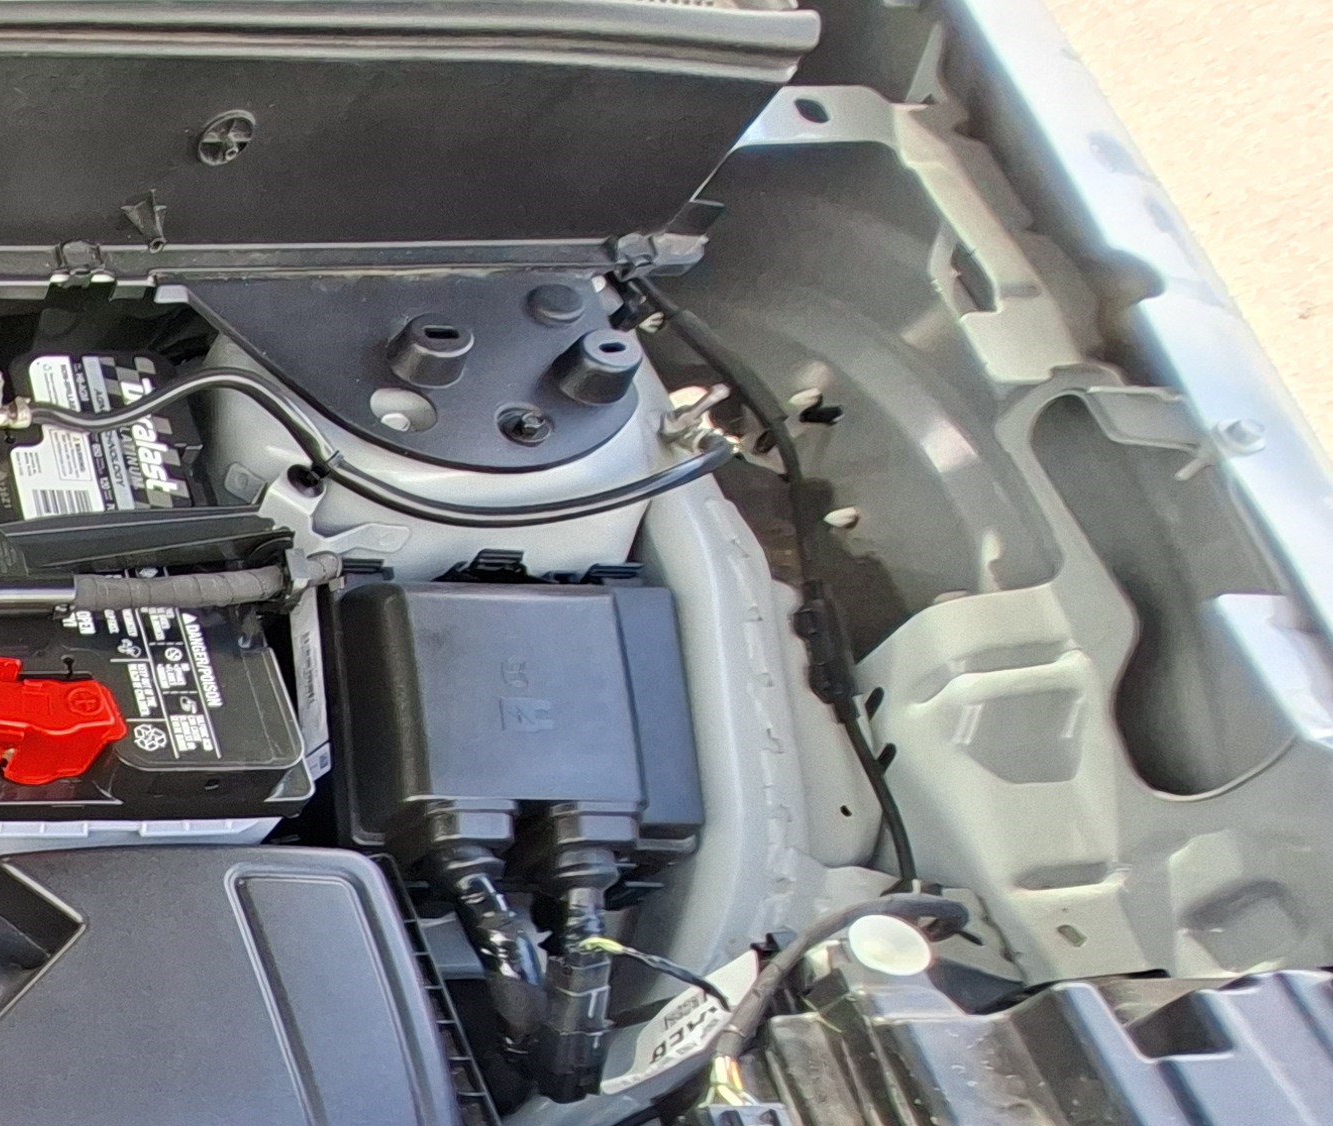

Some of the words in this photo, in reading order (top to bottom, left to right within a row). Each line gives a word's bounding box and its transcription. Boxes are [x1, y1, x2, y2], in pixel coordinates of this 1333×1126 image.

[119, 427, 145, 489] LATINUM
[121, 378, 178, 492] Dralast
[185, 624, 223, 707] DANGER/POISON
